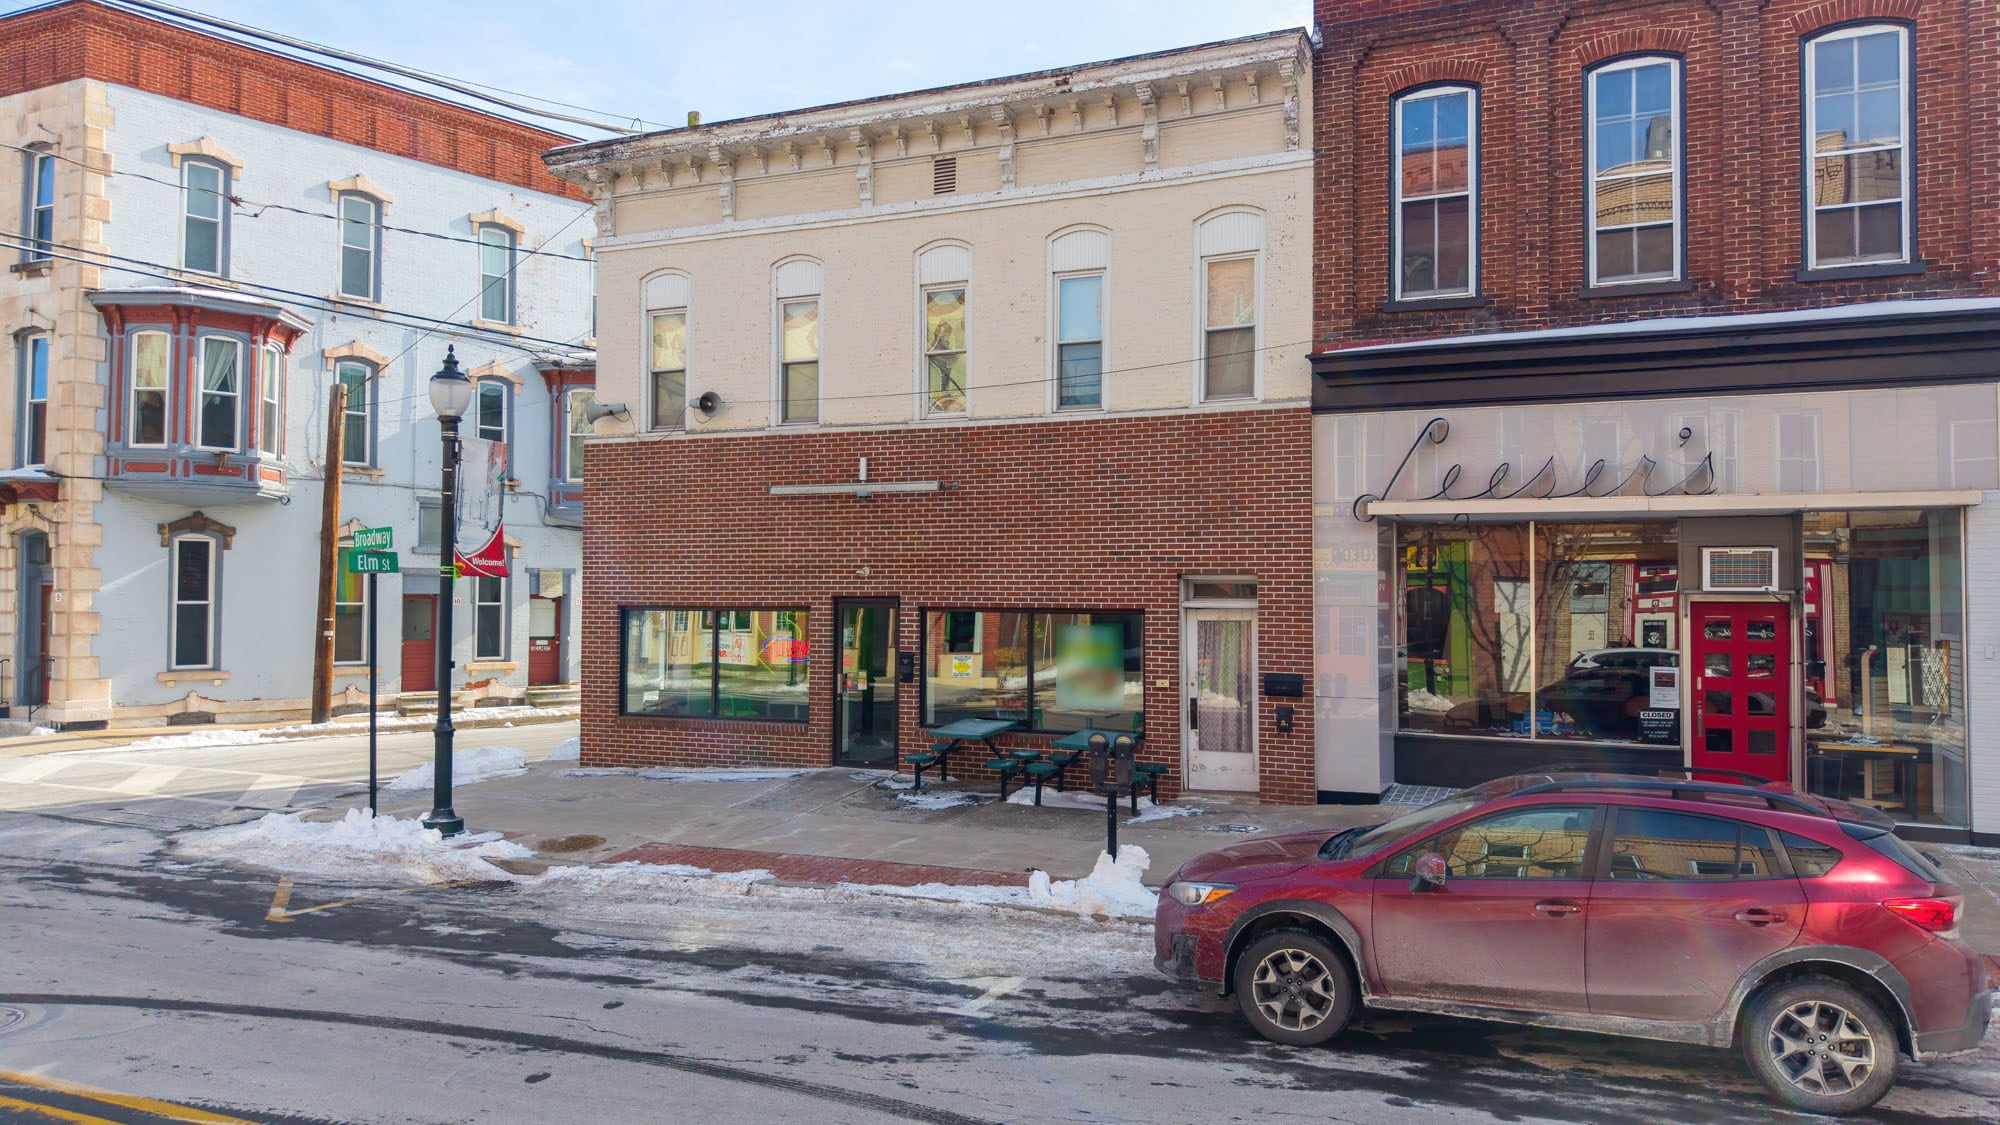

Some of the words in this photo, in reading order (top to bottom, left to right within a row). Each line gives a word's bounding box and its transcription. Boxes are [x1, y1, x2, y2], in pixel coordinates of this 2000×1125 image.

[356, 530, 390, 549] Broadway
[358, 553, 379, 570] Elm
[472, 557, 504, 567] Welcome!
